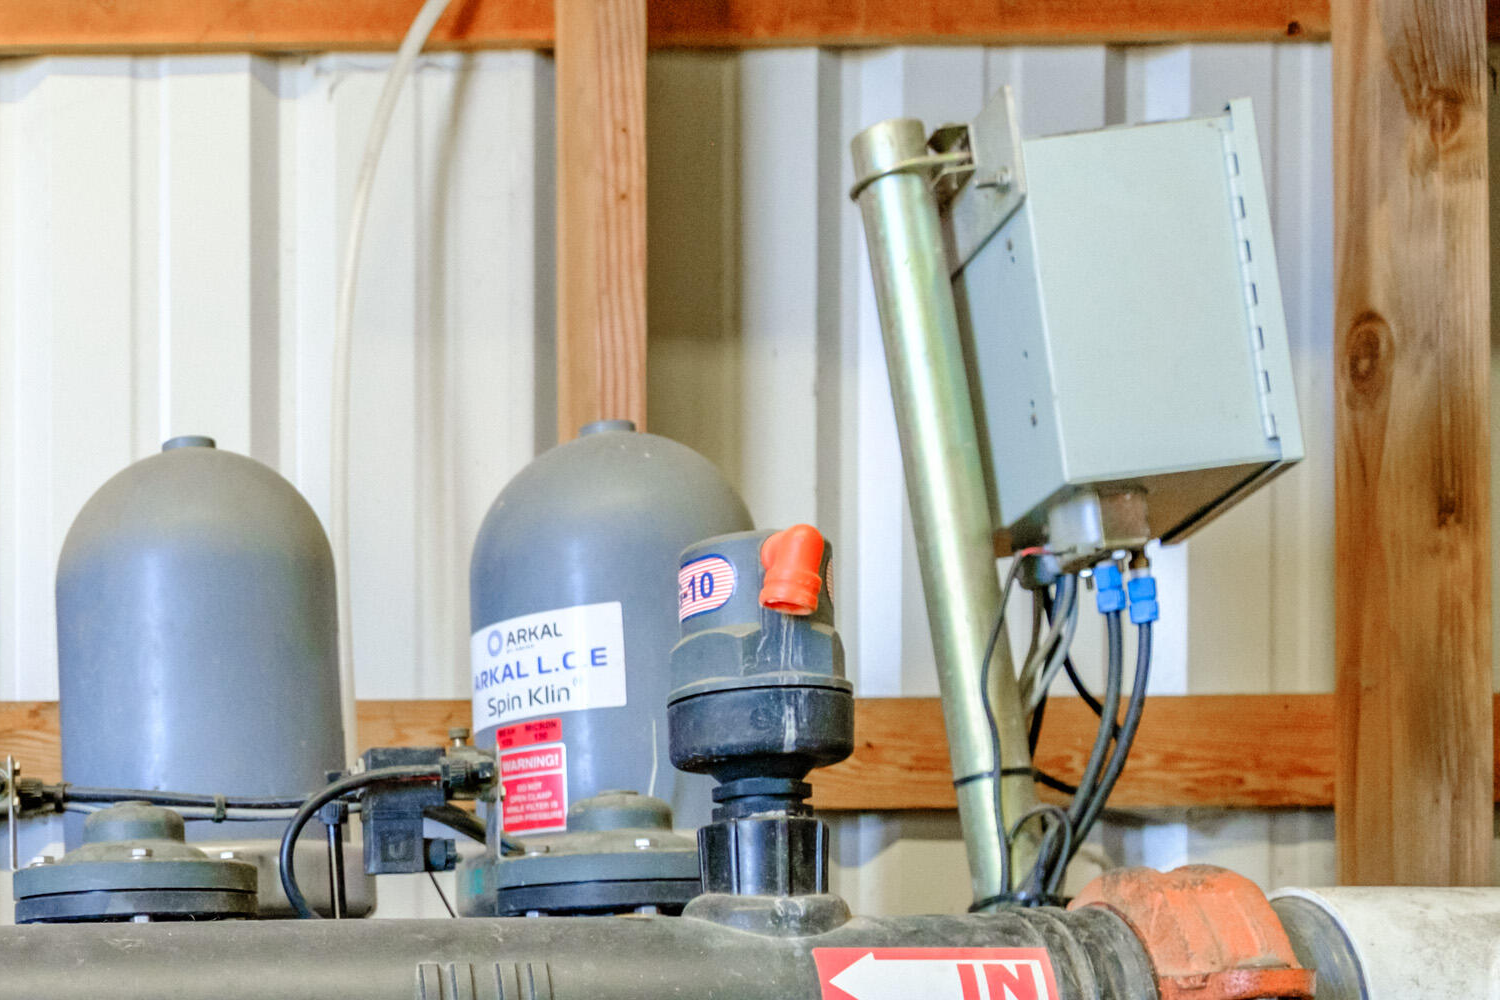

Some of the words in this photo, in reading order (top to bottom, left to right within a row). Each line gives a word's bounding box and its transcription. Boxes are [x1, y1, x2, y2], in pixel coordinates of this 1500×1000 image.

[507, 621, 563, 648] ARKAL
[474, 660, 529, 691] ARKAL
[488, 692, 522, 719] Spin
[501, 753, 559, 773] WARNING!
